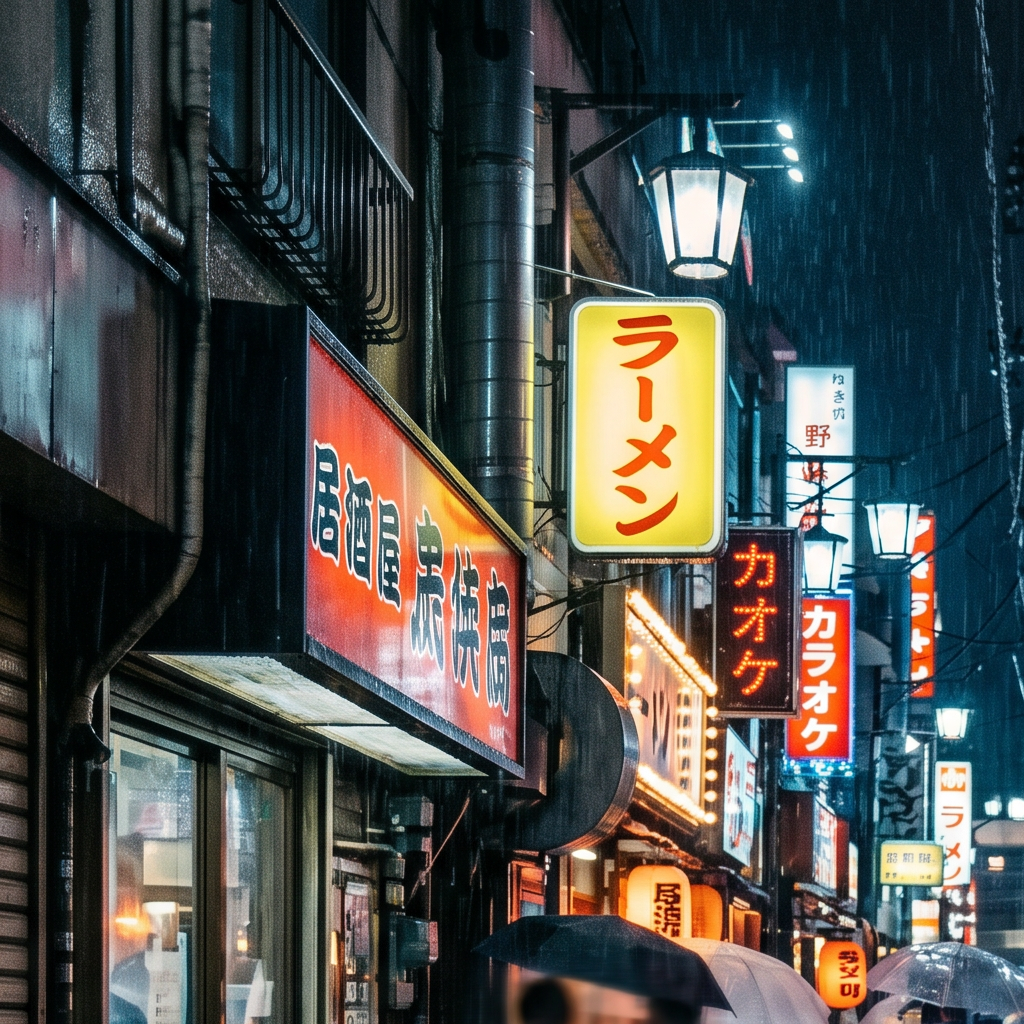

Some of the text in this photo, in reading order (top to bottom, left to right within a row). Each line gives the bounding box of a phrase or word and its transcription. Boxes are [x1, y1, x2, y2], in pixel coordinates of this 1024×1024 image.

[613, 314, 679, 537] ラーメン
[732, 541, 779, 696] カオケ
[801, 605, 838, 752] カラオケ
